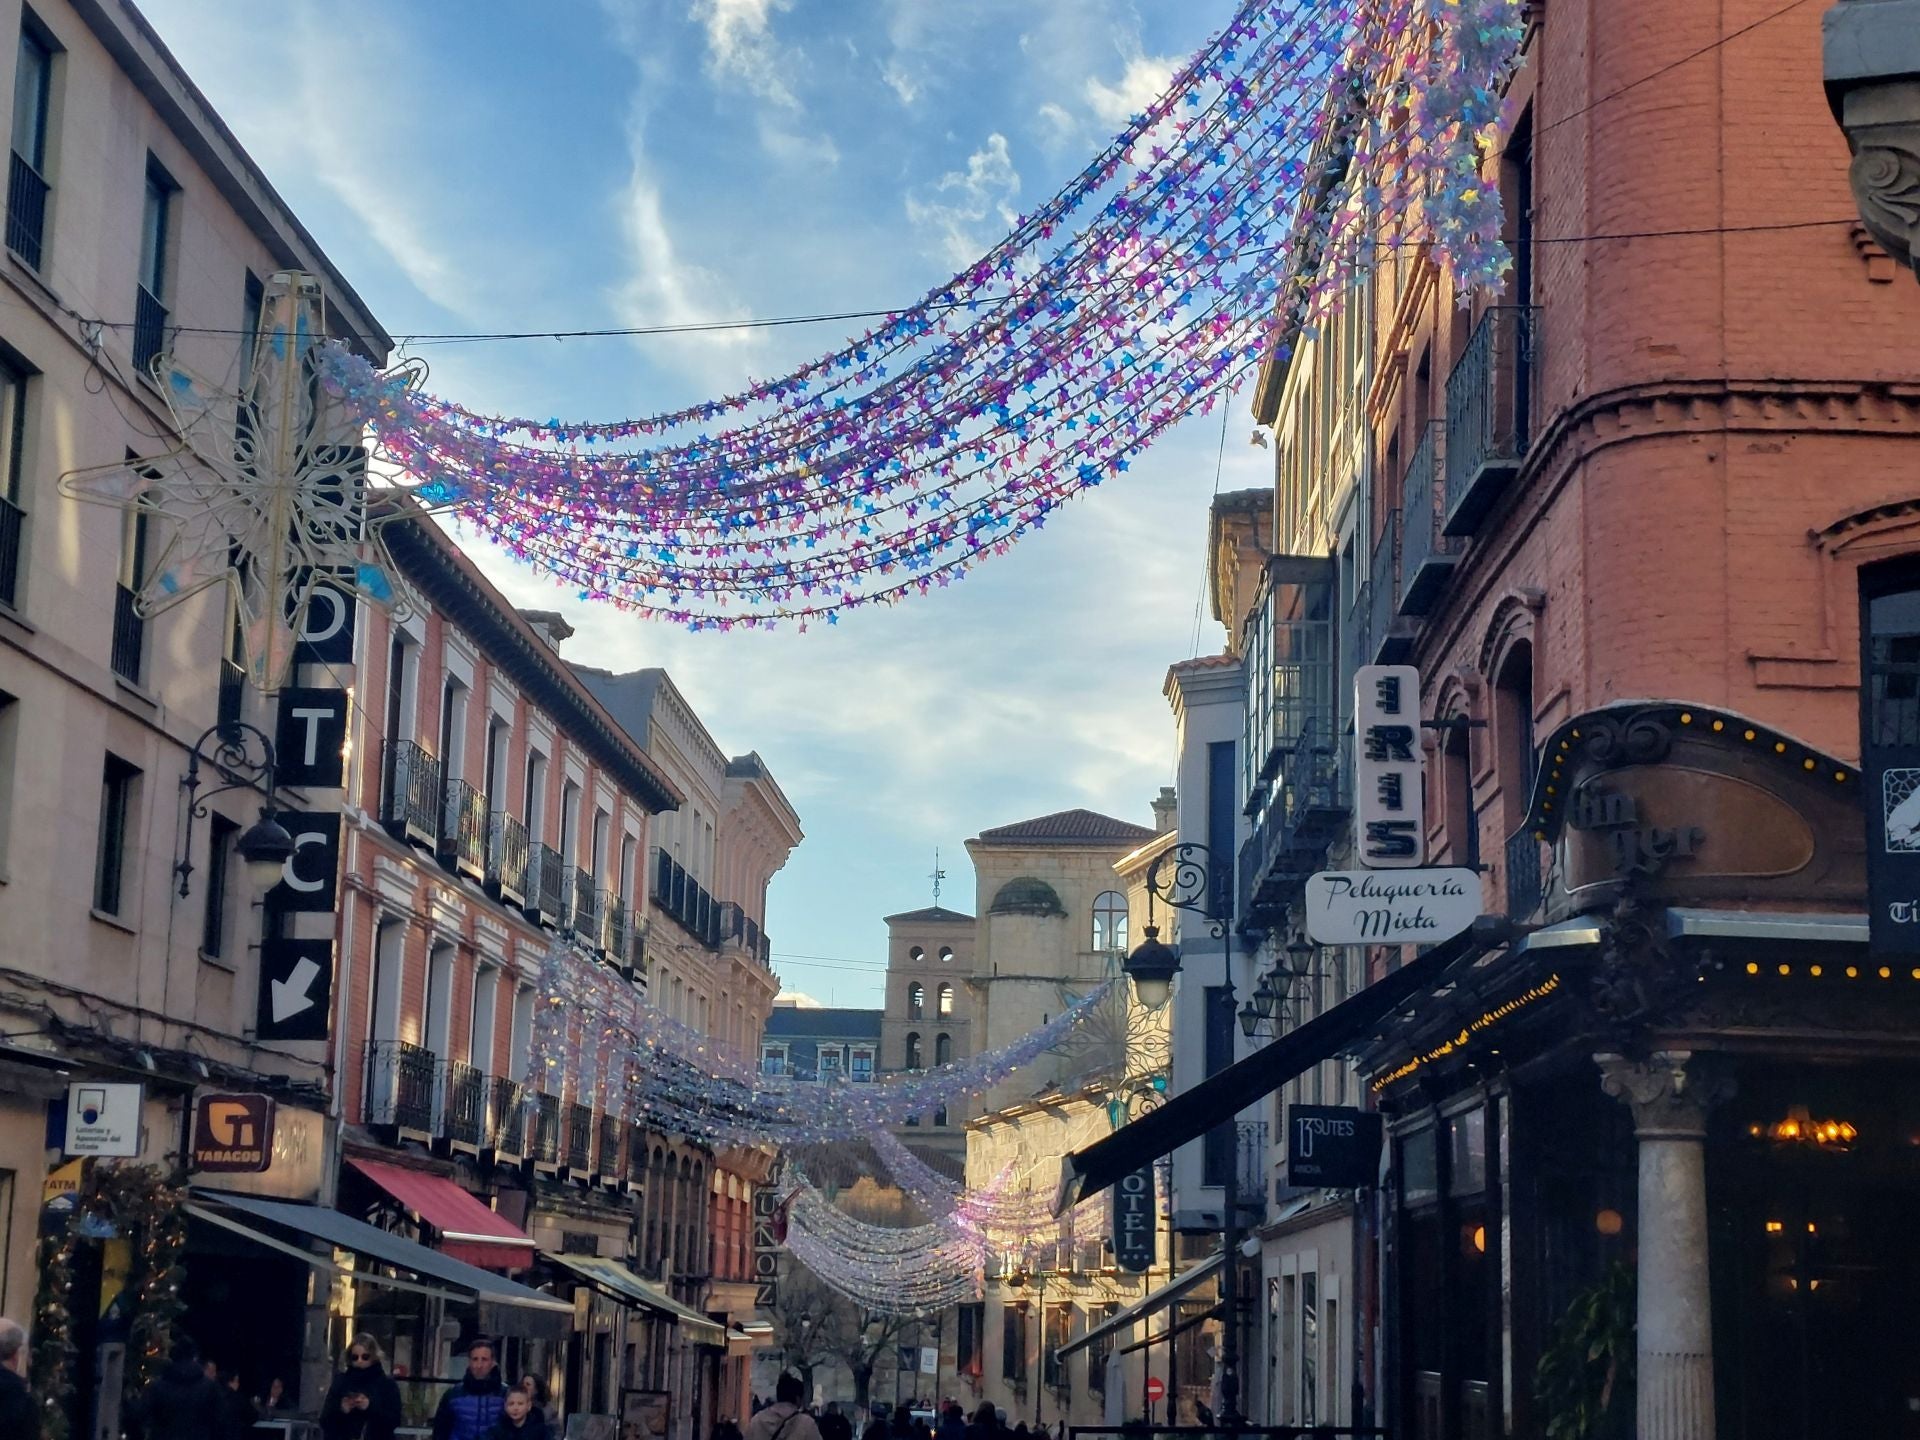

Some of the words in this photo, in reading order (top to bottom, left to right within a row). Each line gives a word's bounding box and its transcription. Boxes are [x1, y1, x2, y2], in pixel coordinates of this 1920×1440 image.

[1364, 675, 1417, 858] IRIS
[1322, 875, 1466, 911] Peluquería
[1353, 905, 1439, 937] Mixta
[196, 1150, 261, 1163] TABACOS
[48, 1179, 76, 1190] ATM
[1121, 1168, 1145, 1250] OTEL
